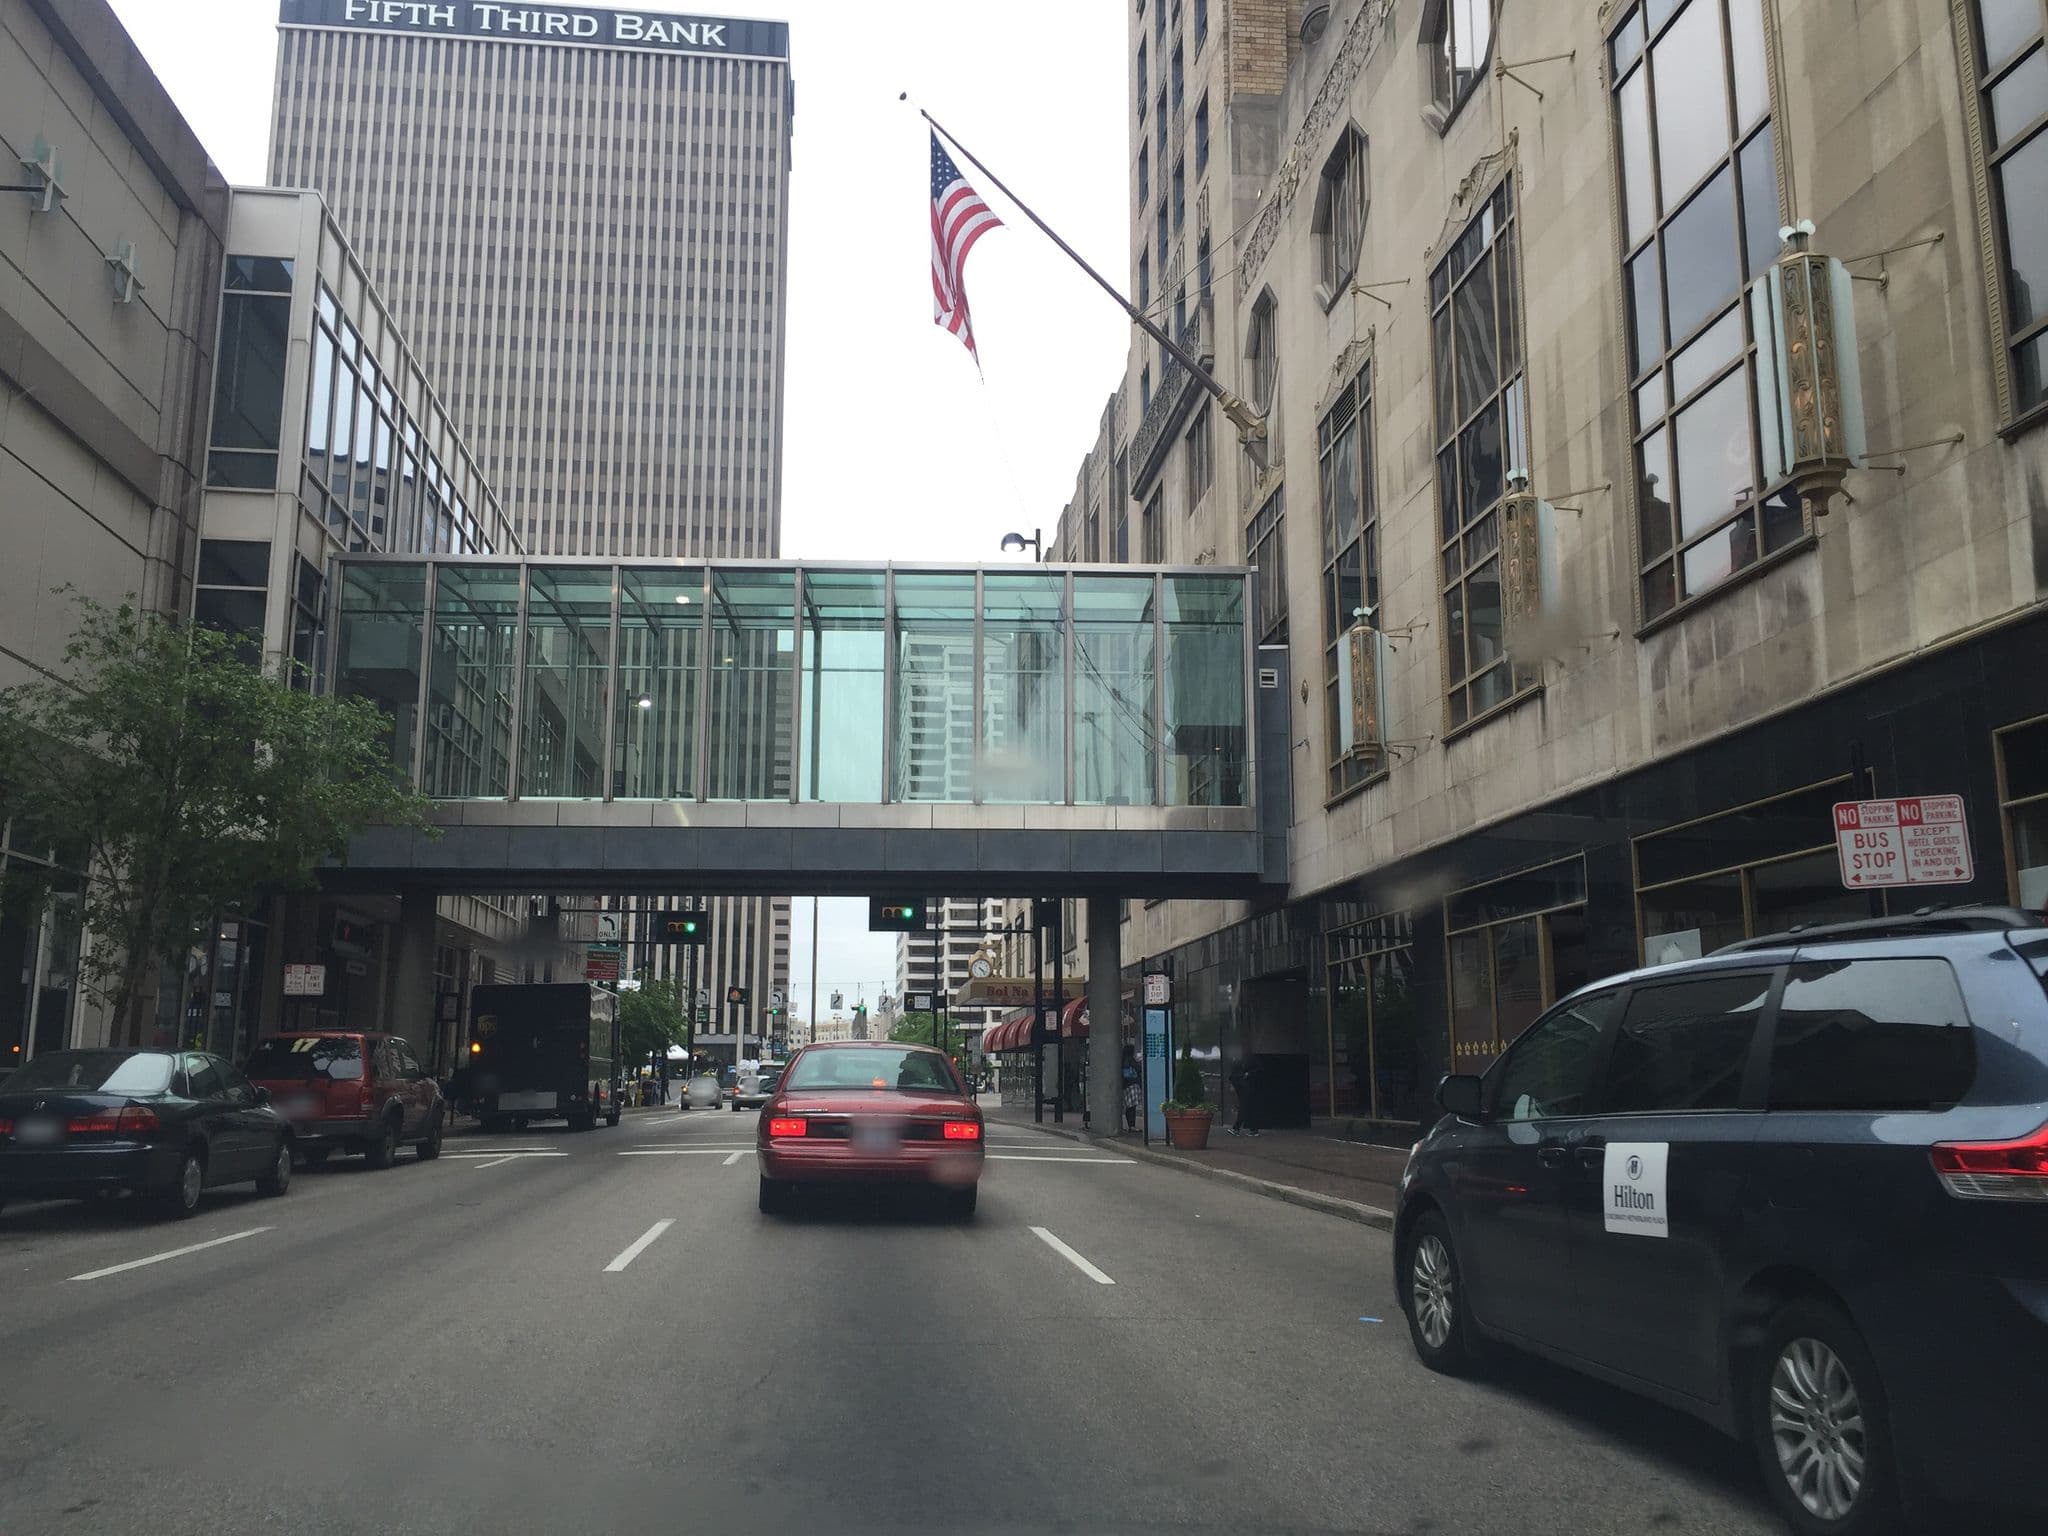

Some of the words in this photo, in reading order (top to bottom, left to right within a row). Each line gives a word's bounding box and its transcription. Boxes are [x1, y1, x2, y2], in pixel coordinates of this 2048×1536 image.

[344, 0, 455, 28] FIFTH
[473, 4, 598, 38] THIRD
[615, 14, 726, 47] BANK
[1860, 804, 1895, 815] STOPPING
[1923, 800, 1958, 810] STOPPING
[1839, 809, 1857, 825] NO
[1901, 804, 1920, 821] NO
[1926, 810, 1957, 820] PARKING
[1863, 814, 1895, 824] PARKING
[1913, 827, 1950, 836] EXCEPT
[1854, 832, 1889, 849] BUS
[1908, 838, 1930, 847] HOTEL
[1913, 846, 1958, 857] CHECKING
[1852, 851, 1896, 869] STOP
[1912, 859, 1921, 867] IN
[1923, 857, 1942, 866] AND
[1944, 856, 1961, 865] OUT
[1614, 1185, 1655, 1210] Hilton
